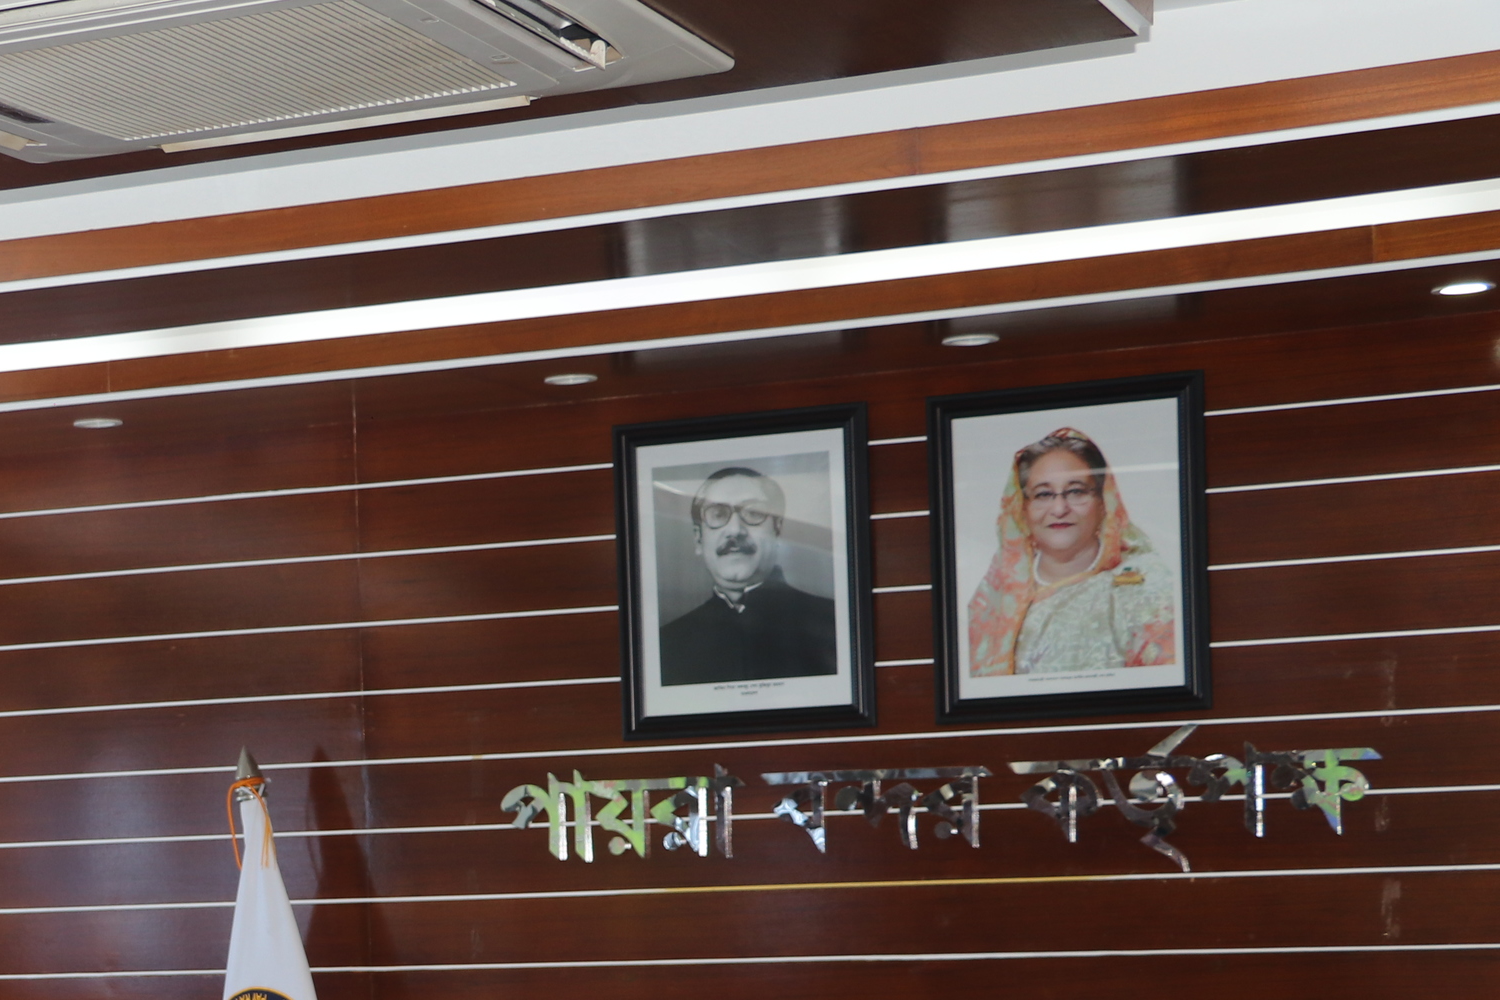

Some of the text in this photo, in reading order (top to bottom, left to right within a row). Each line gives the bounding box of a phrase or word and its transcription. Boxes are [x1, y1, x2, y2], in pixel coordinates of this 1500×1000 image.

[501, 723, 1382, 873] পায়রা বন্দর কর্তৃপক্ষ
